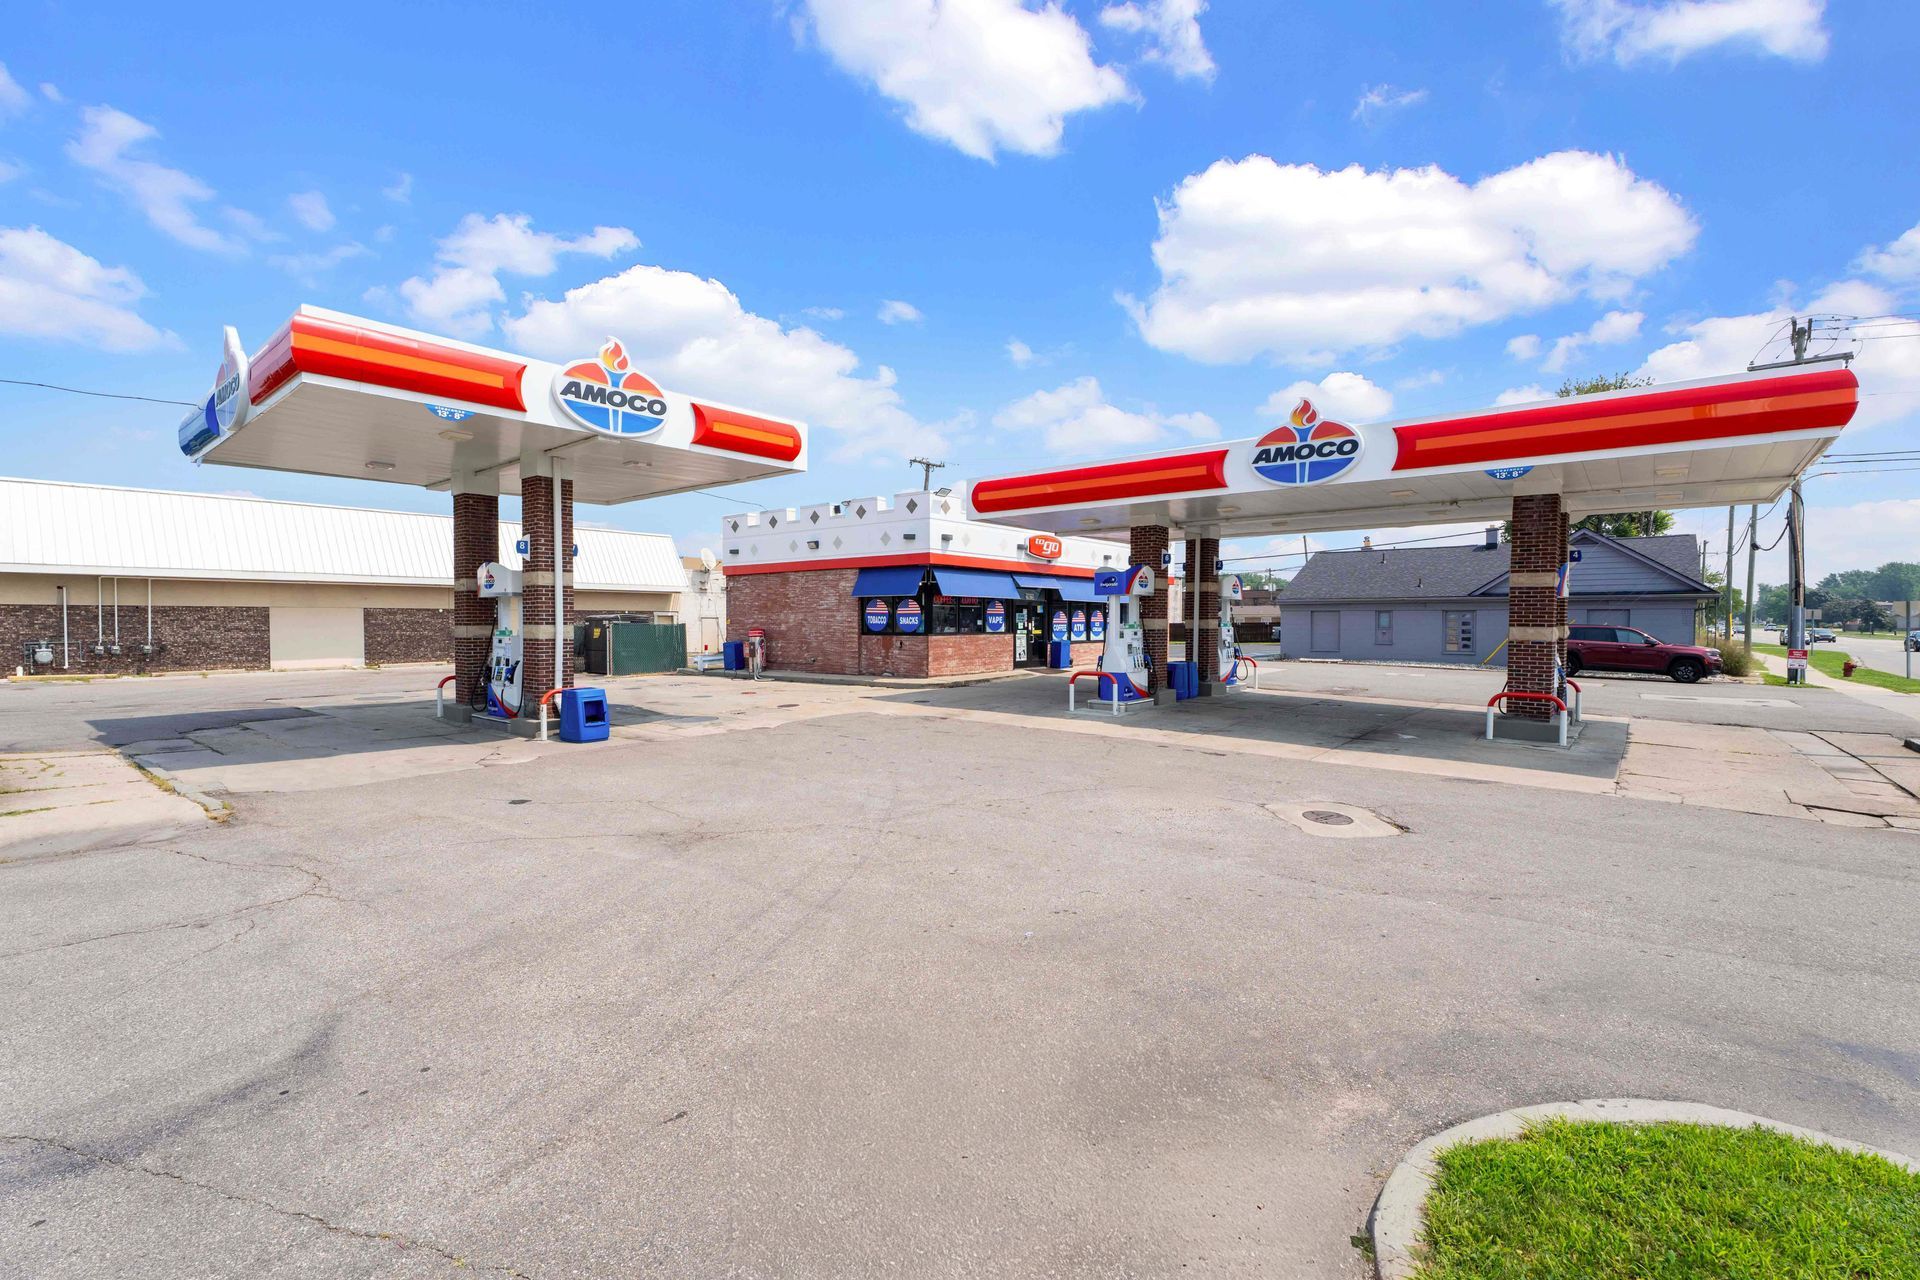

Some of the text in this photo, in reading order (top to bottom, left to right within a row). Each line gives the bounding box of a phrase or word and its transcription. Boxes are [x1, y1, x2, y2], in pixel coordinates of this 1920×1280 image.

[560, 380, 667, 416] AMOCO
[1252, 439, 1359, 464] AMOCO
[519, 541, 525, 549] 8
[1042, 541, 1059, 555] go
[867, 615, 887, 625] TOBACCO
[899, 616, 919, 625] SNACKS
[988, 616, 1003, 624] VAPE
[1053, 624, 1068, 632] COFFEE
[1073, 623, 1085, 632] ATM
